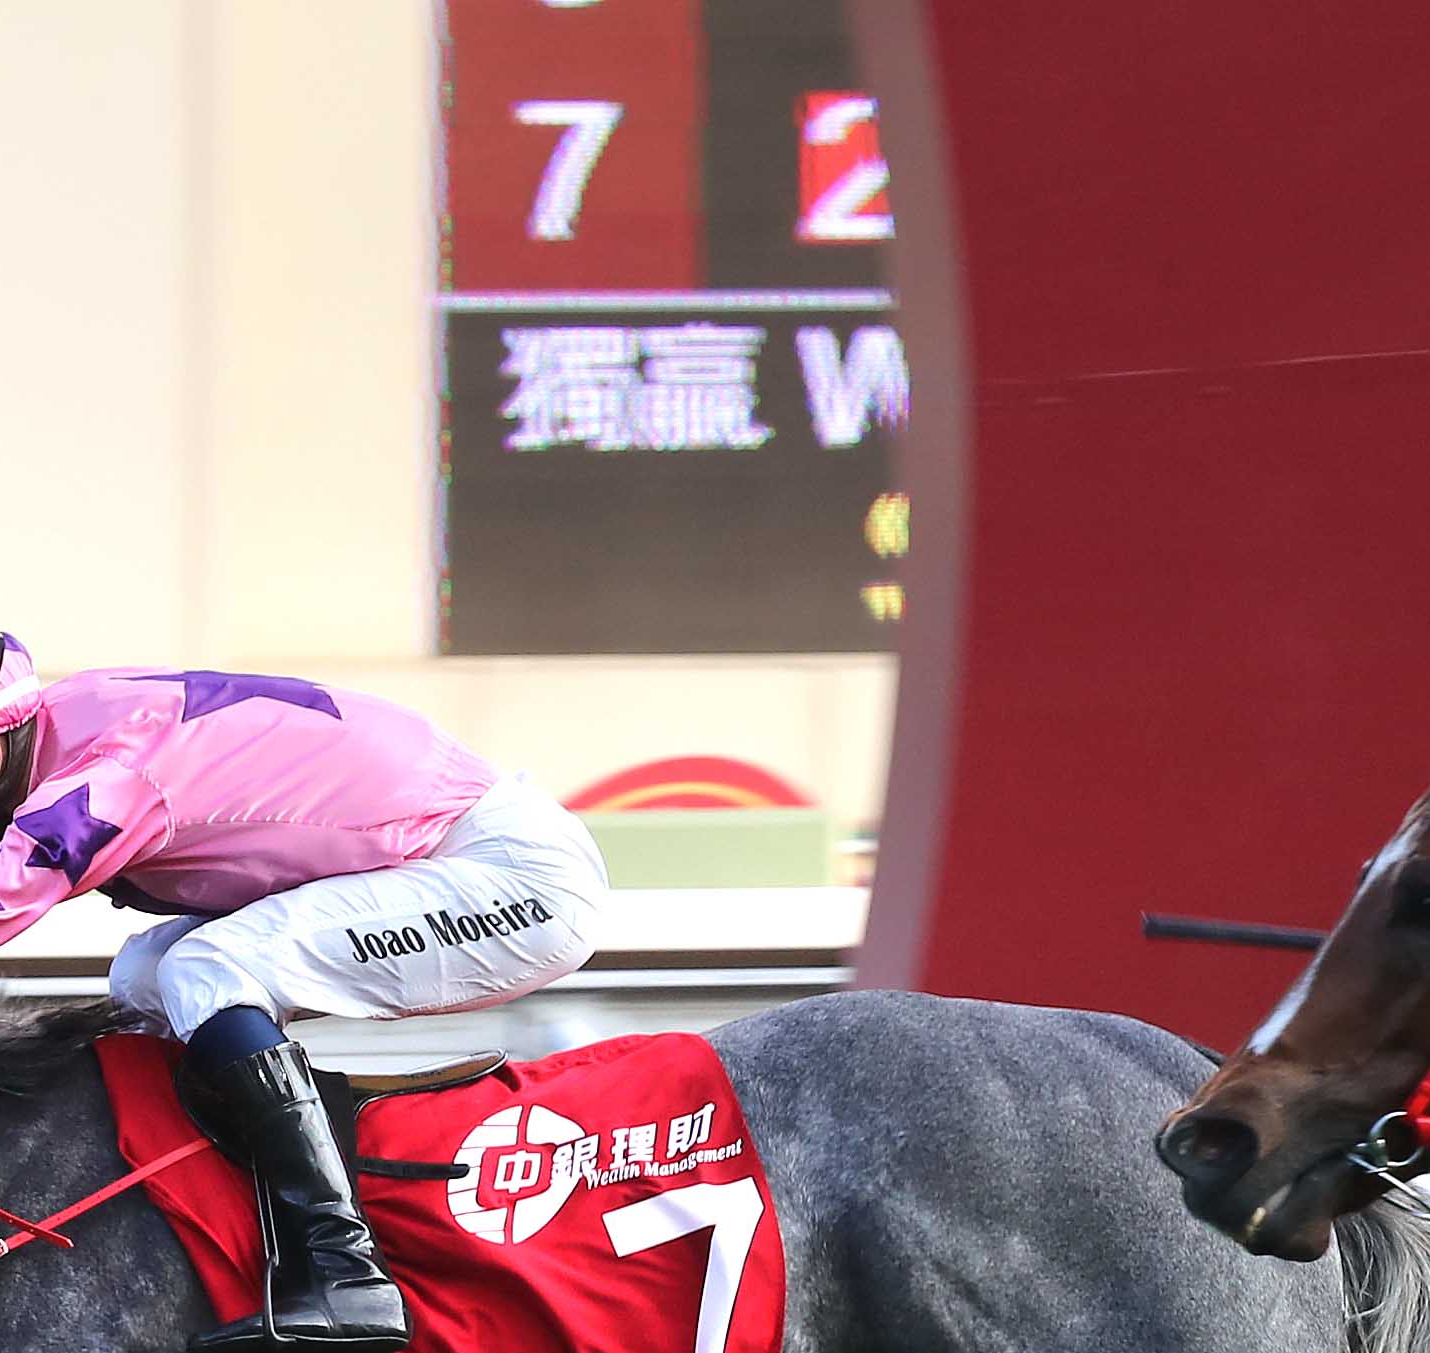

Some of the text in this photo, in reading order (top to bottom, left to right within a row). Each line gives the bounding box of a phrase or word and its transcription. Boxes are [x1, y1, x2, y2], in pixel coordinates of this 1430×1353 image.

[511, 100, 625, 241] 7
[345, 898, 555, 964] Joao Moreira
[581, 1137, 744, 1191] Wealth Management
